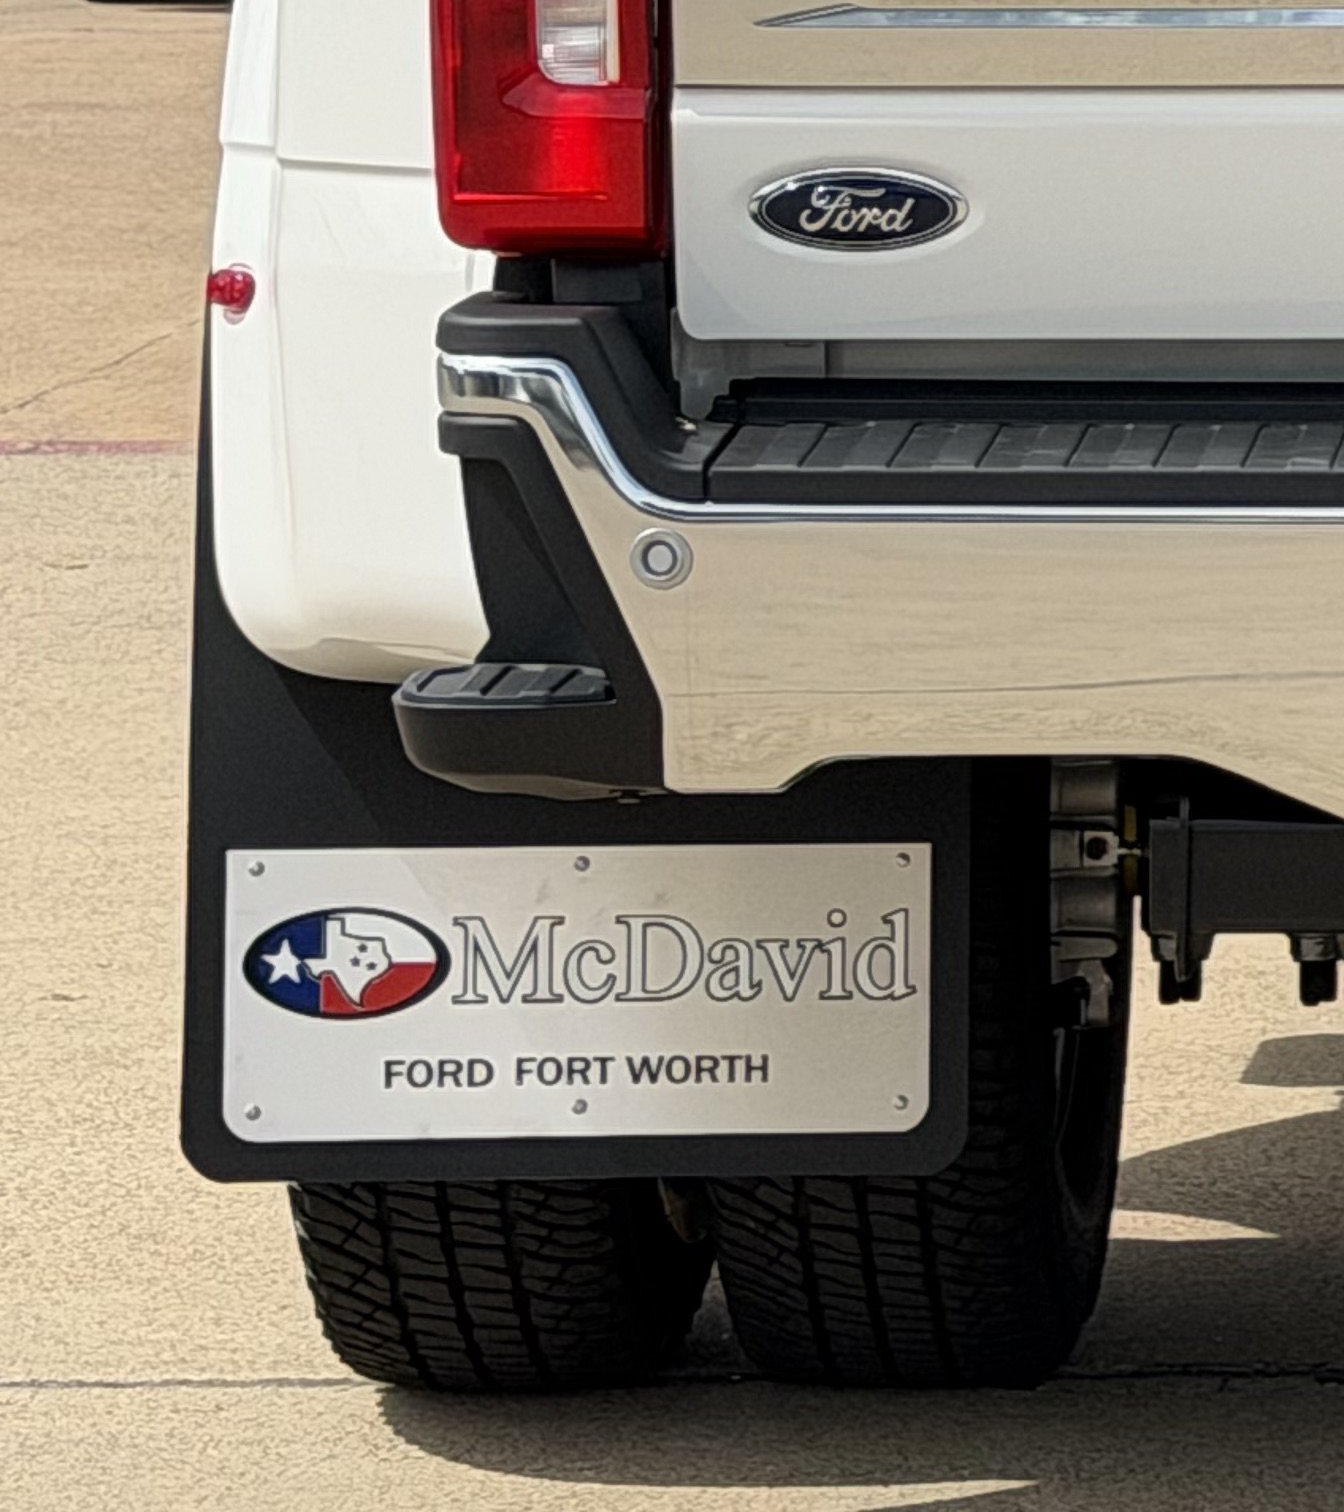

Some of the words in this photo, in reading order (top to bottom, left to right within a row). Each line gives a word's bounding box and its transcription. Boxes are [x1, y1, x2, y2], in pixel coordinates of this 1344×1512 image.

[800, 185, 916, 233] Ford
[451, 907, 918, 1005] McDavid
[383, 1058, 495, 1089] FORD
[514, 1056, 616, 1087] FORT
[625, 1054, 770, 1086] WORTH
